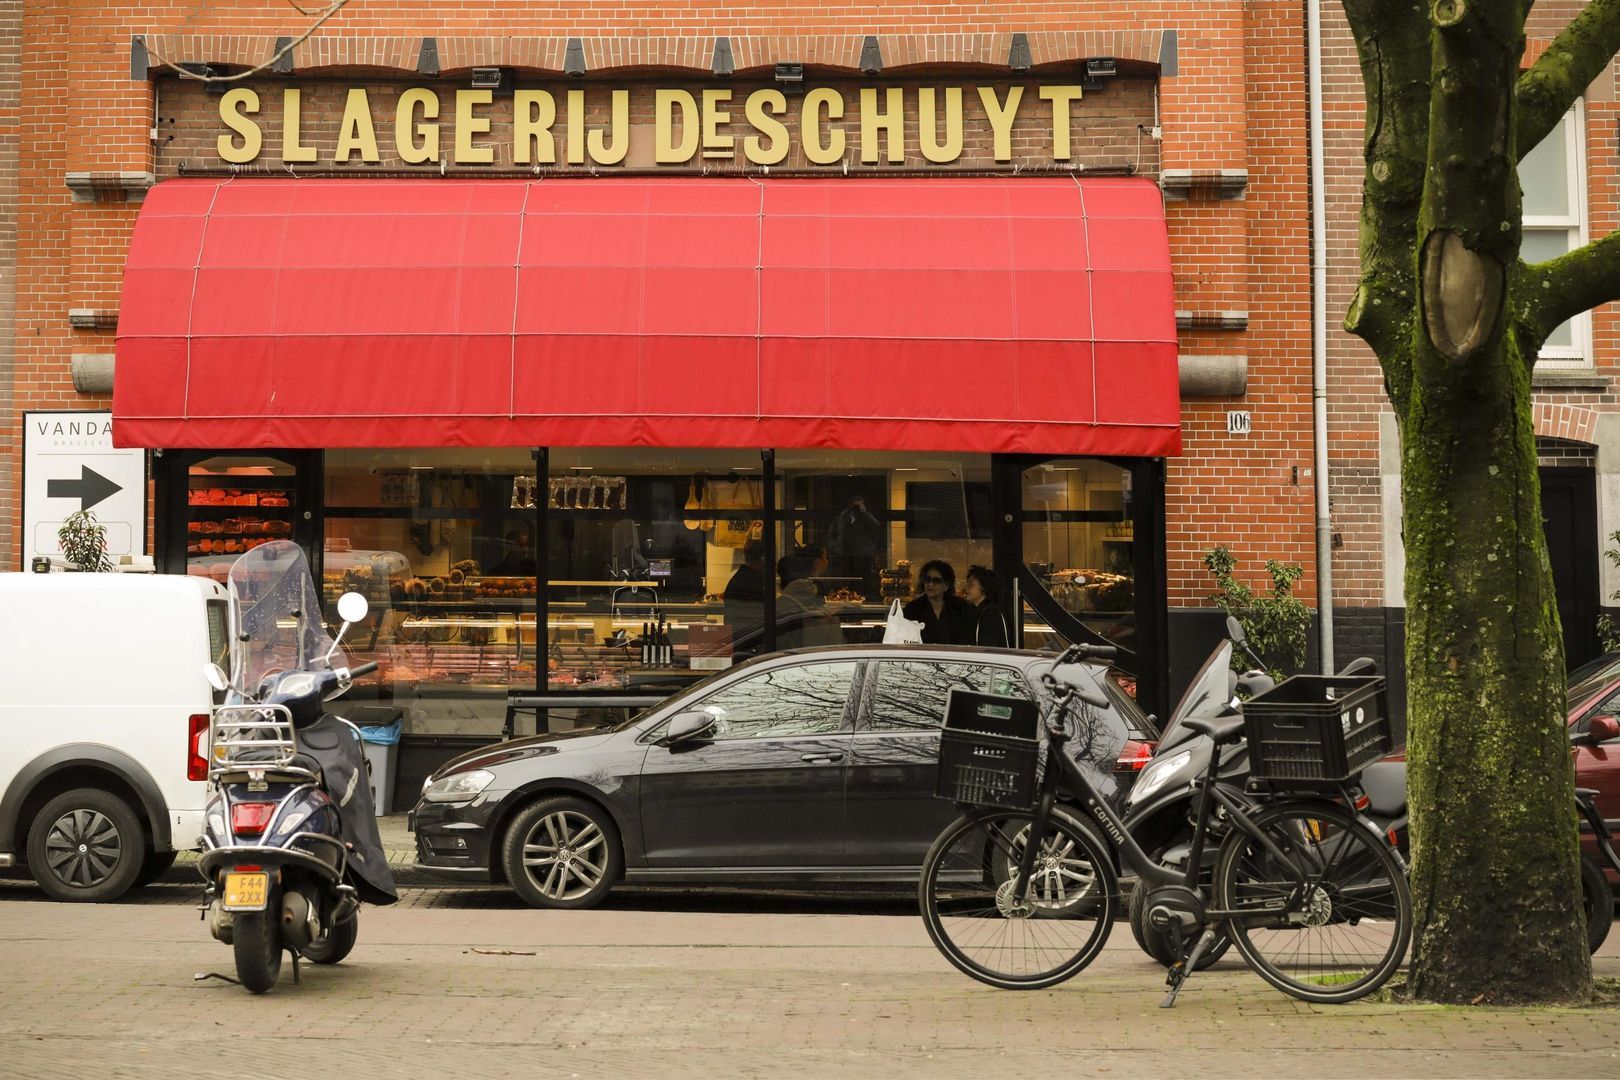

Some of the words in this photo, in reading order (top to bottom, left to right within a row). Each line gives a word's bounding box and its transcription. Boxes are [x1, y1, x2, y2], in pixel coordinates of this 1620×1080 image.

[217, 88, 629, 165] SLAGERIJ
[1230, 413, 1250, 431] 106
[1094, 806, 1125, 845] CORTINA
[240, 877, 263, 889] F44
[239, 891, 262, 903] 2XX
